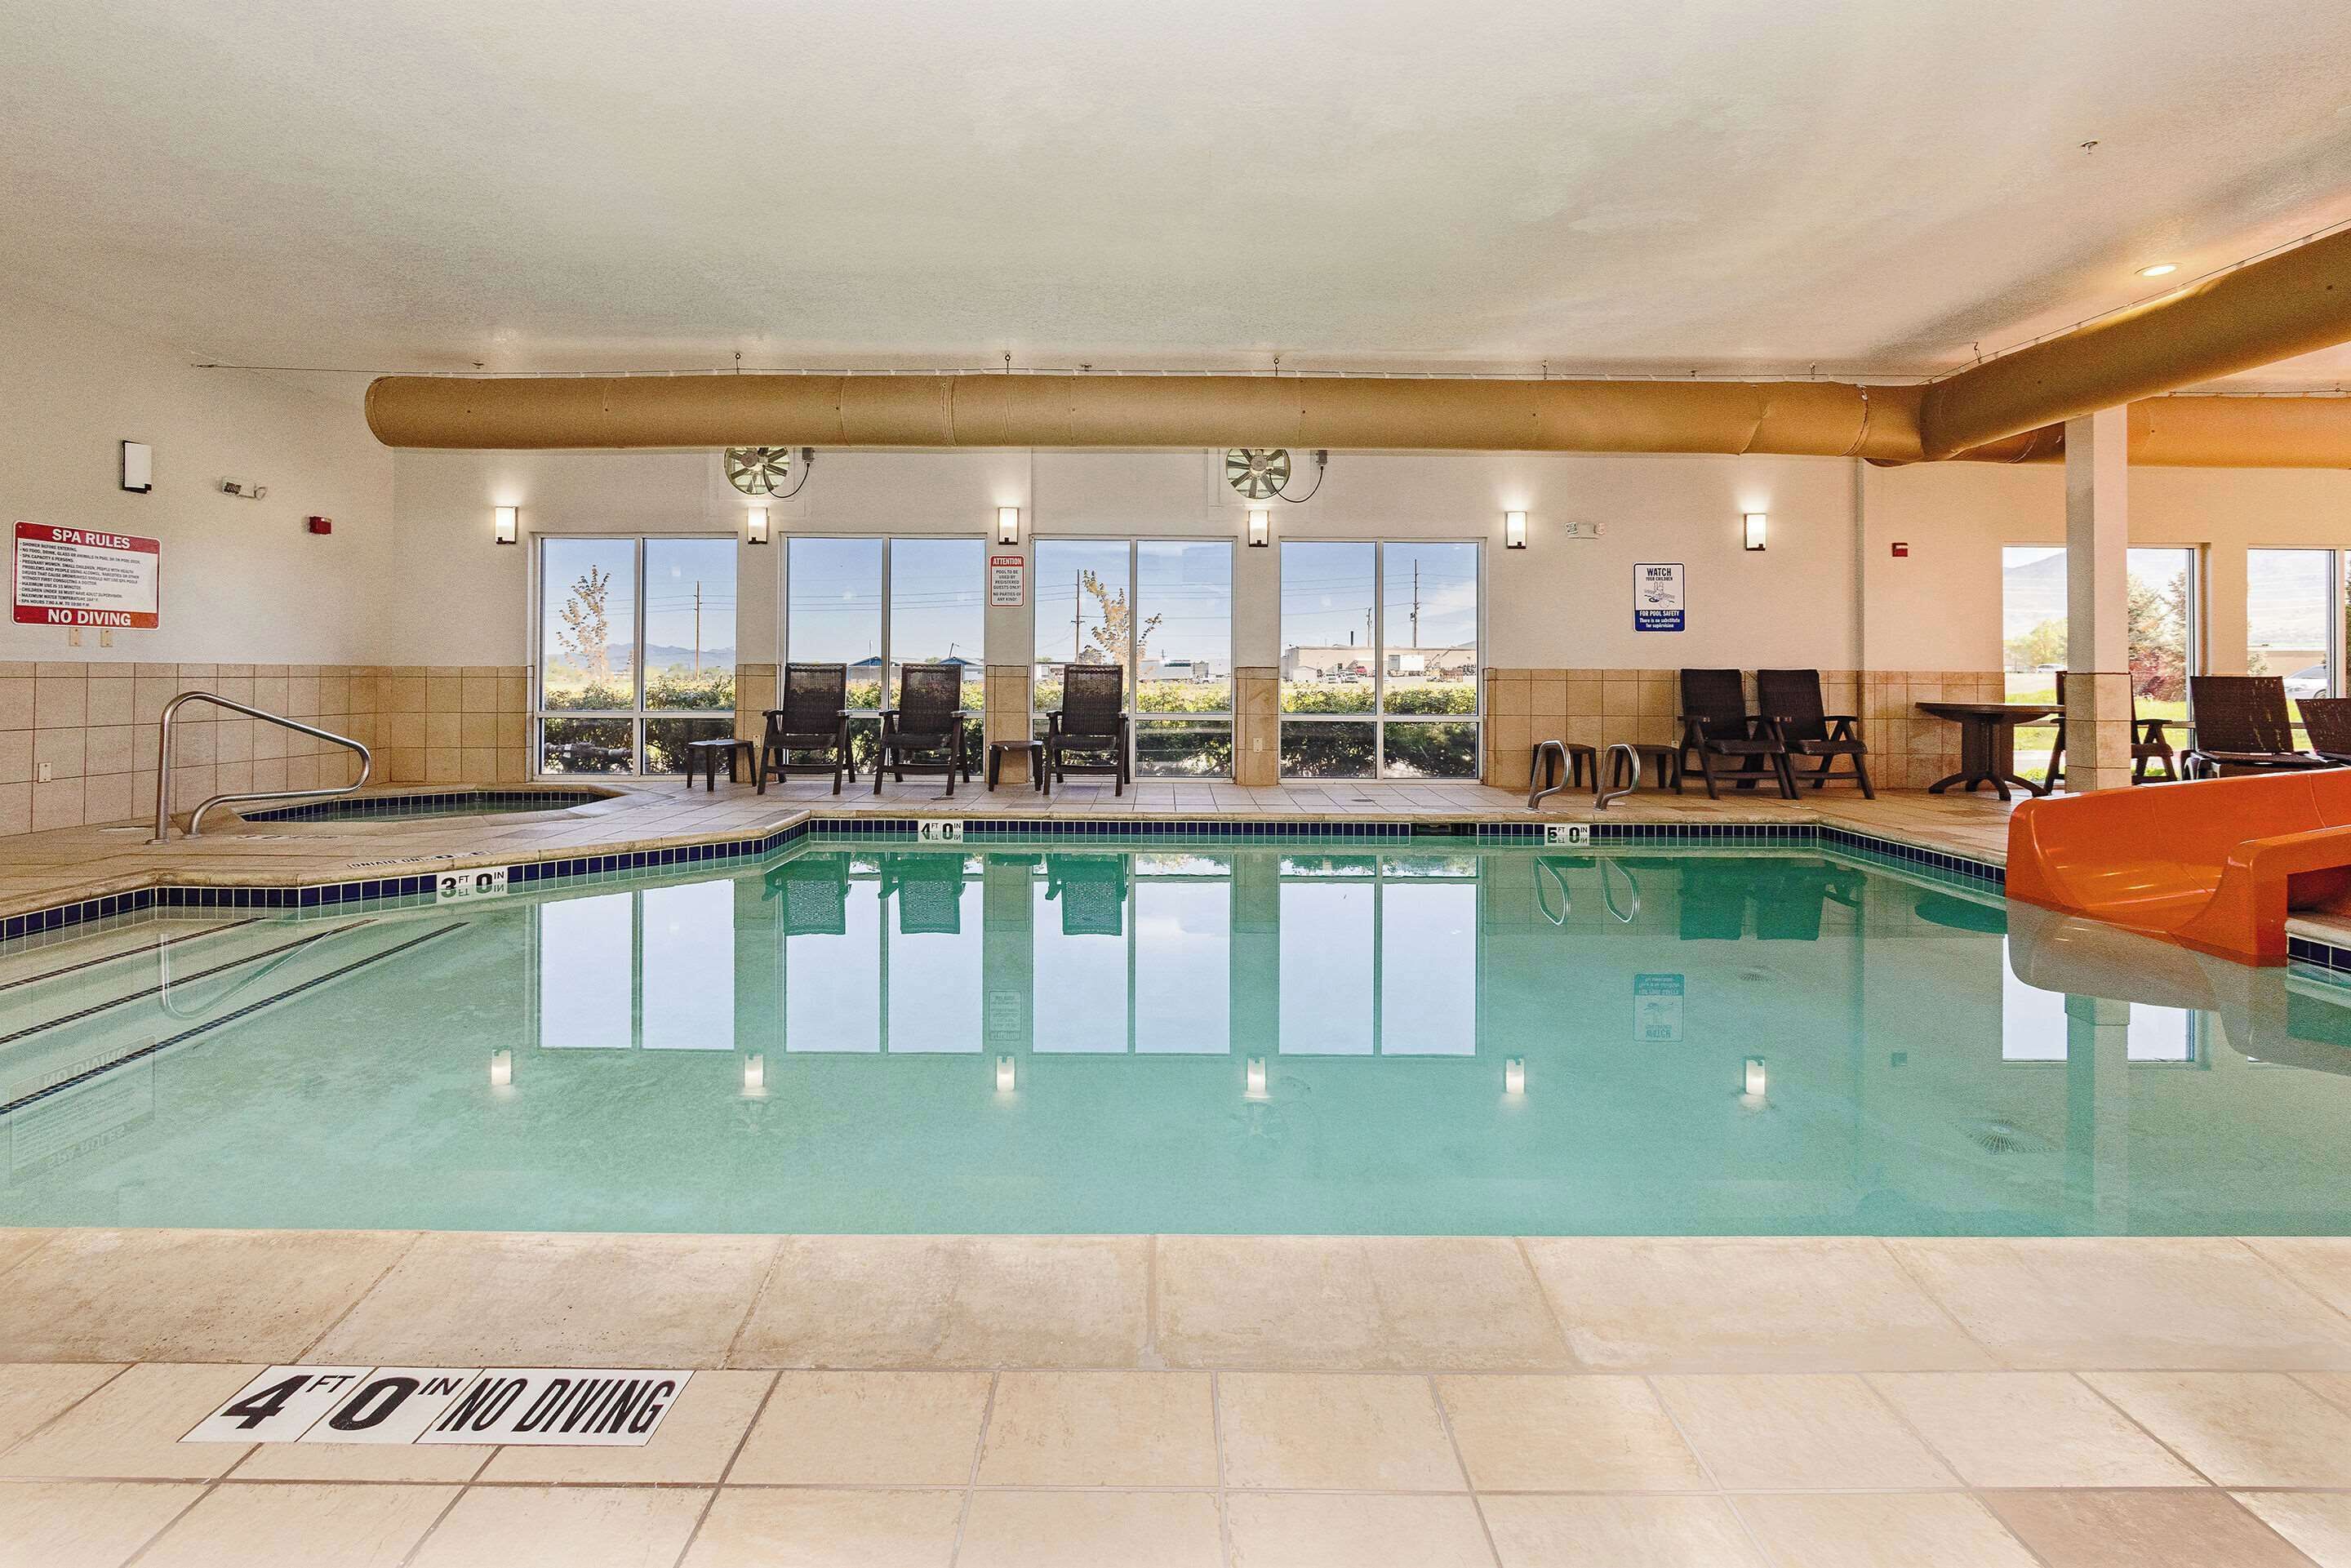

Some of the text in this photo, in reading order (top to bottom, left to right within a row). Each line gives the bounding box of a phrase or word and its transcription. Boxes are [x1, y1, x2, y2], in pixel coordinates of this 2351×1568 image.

[52, 528, 131, 549] SPA RULES
[1647, 567, 1672, 576] WATCH
[47, 609, 131, 626] NO DIVING
[921, 823, 931, 837] 4
[942, 823, 953, 837] 0
[1569, 827, 1580, 842] 0
[351, 860, 398, 868] DIVING
[441, 871, 504, 895] 3 FT 0 IN
[221, 1375, 676, 1435] 4 FT 0 IN NO DIVING
